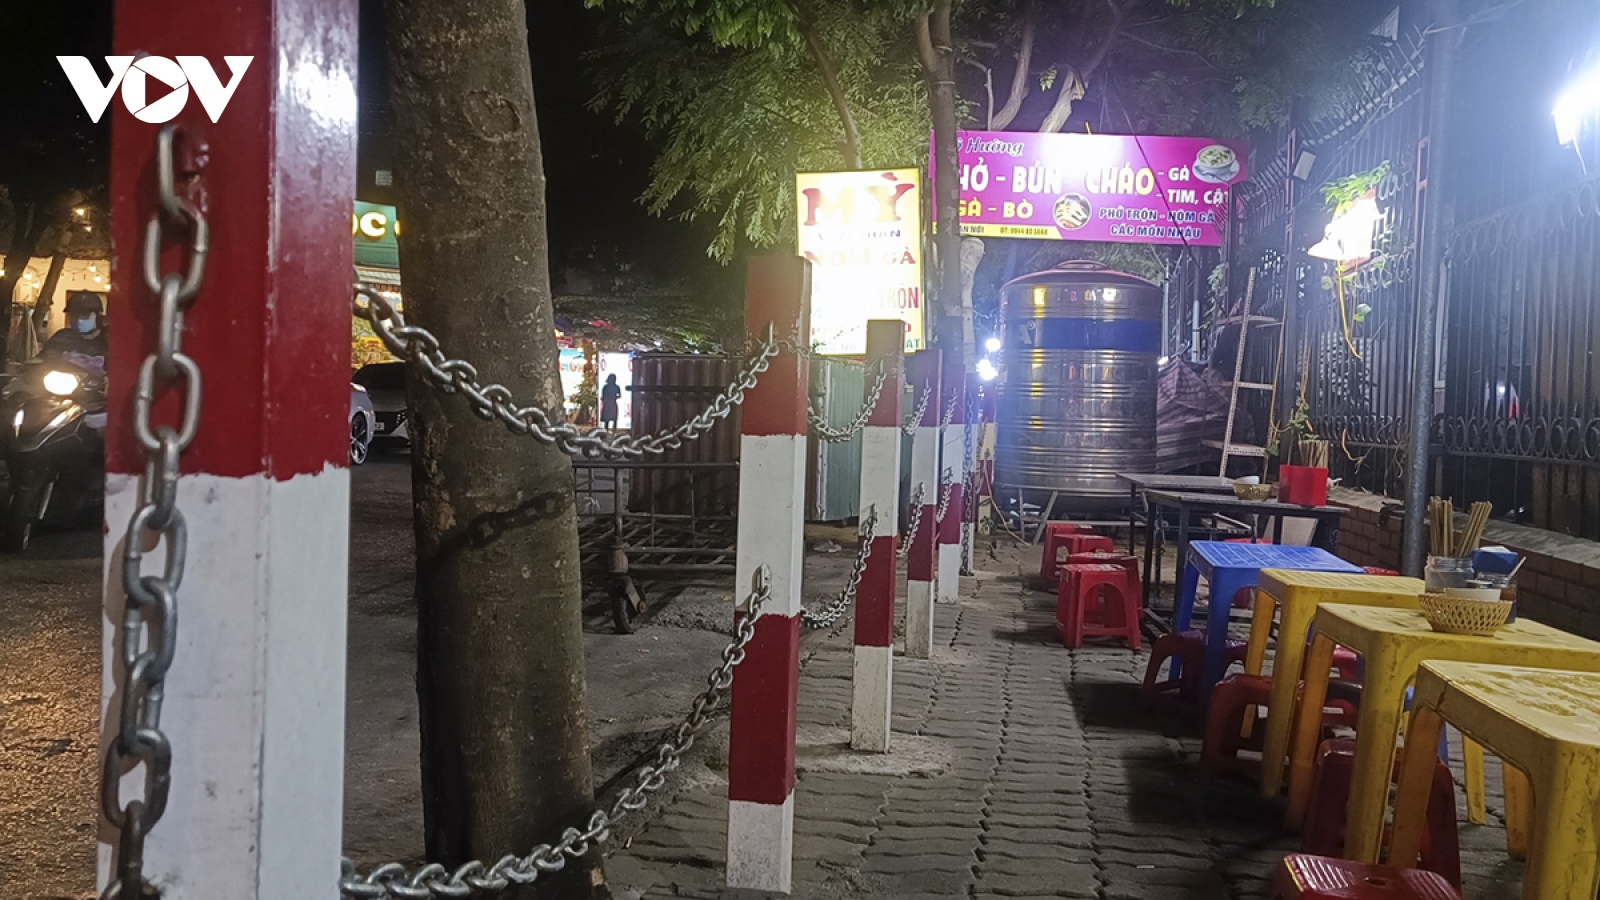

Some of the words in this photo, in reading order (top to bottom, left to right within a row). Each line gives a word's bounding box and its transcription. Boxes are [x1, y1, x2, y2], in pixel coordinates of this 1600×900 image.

[1012, 161, 1062, 194] BÚN
[1085, 161, 1155, 195] CHÁO
[1168, 164, 1190, 181] GÀ
[1167, 189, 1199, 205] TIM,
[1003, 199, 1033, 218] BÒ
[1125, 208, 1157, 222] TRỘN
[1167, 209, 1196, 224] NỘM
[1198, 209, 1215, 222] GÀ
[1110, 223, 1134, 236] CÁC
[1137, 224, 1165, 237] MÓN
